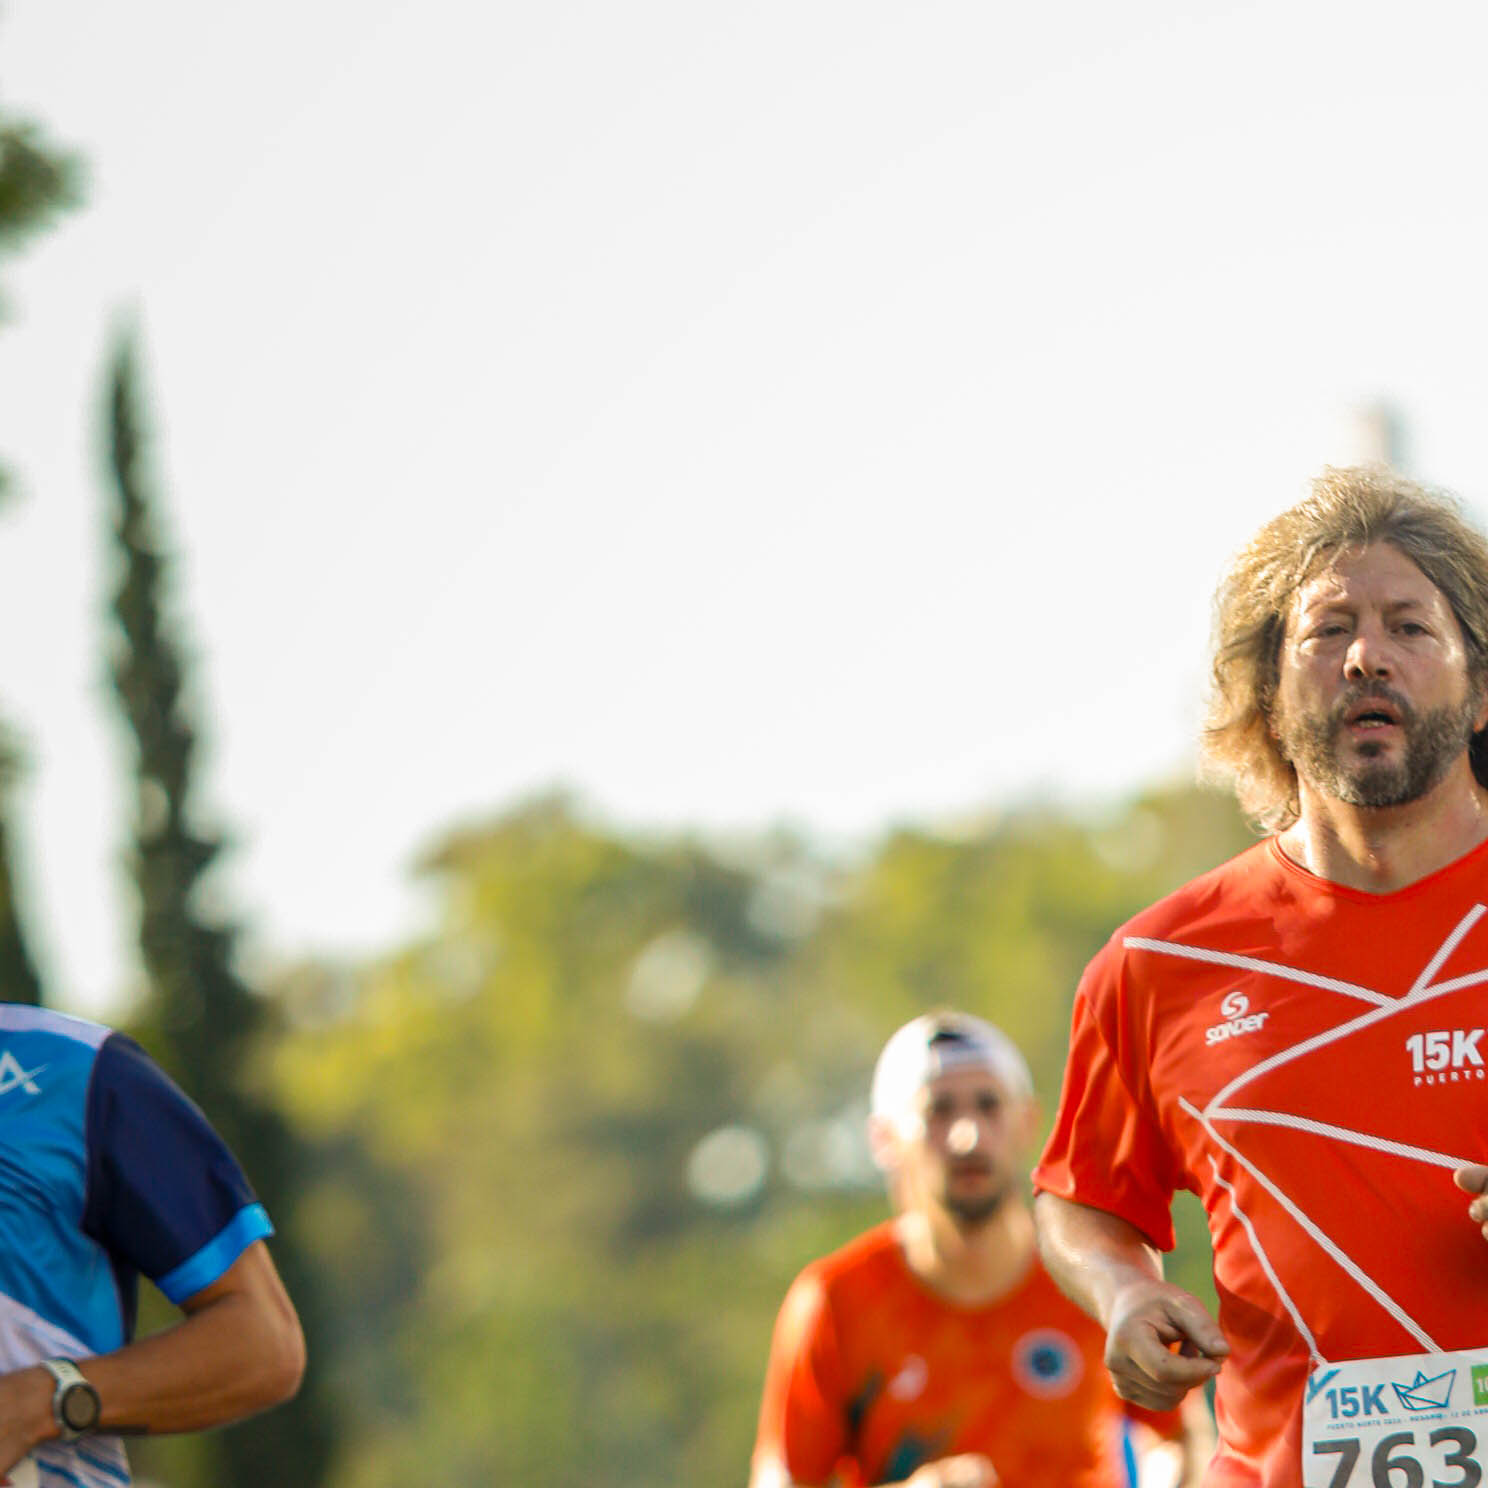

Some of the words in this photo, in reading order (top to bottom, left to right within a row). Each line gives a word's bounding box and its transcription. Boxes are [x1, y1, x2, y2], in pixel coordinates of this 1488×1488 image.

[1405, 1029, 1485, 1073] 15K
[1413, 1069, 1486, 1088] PUERTO
[1325, 1384, 1389, 1419] 15K
